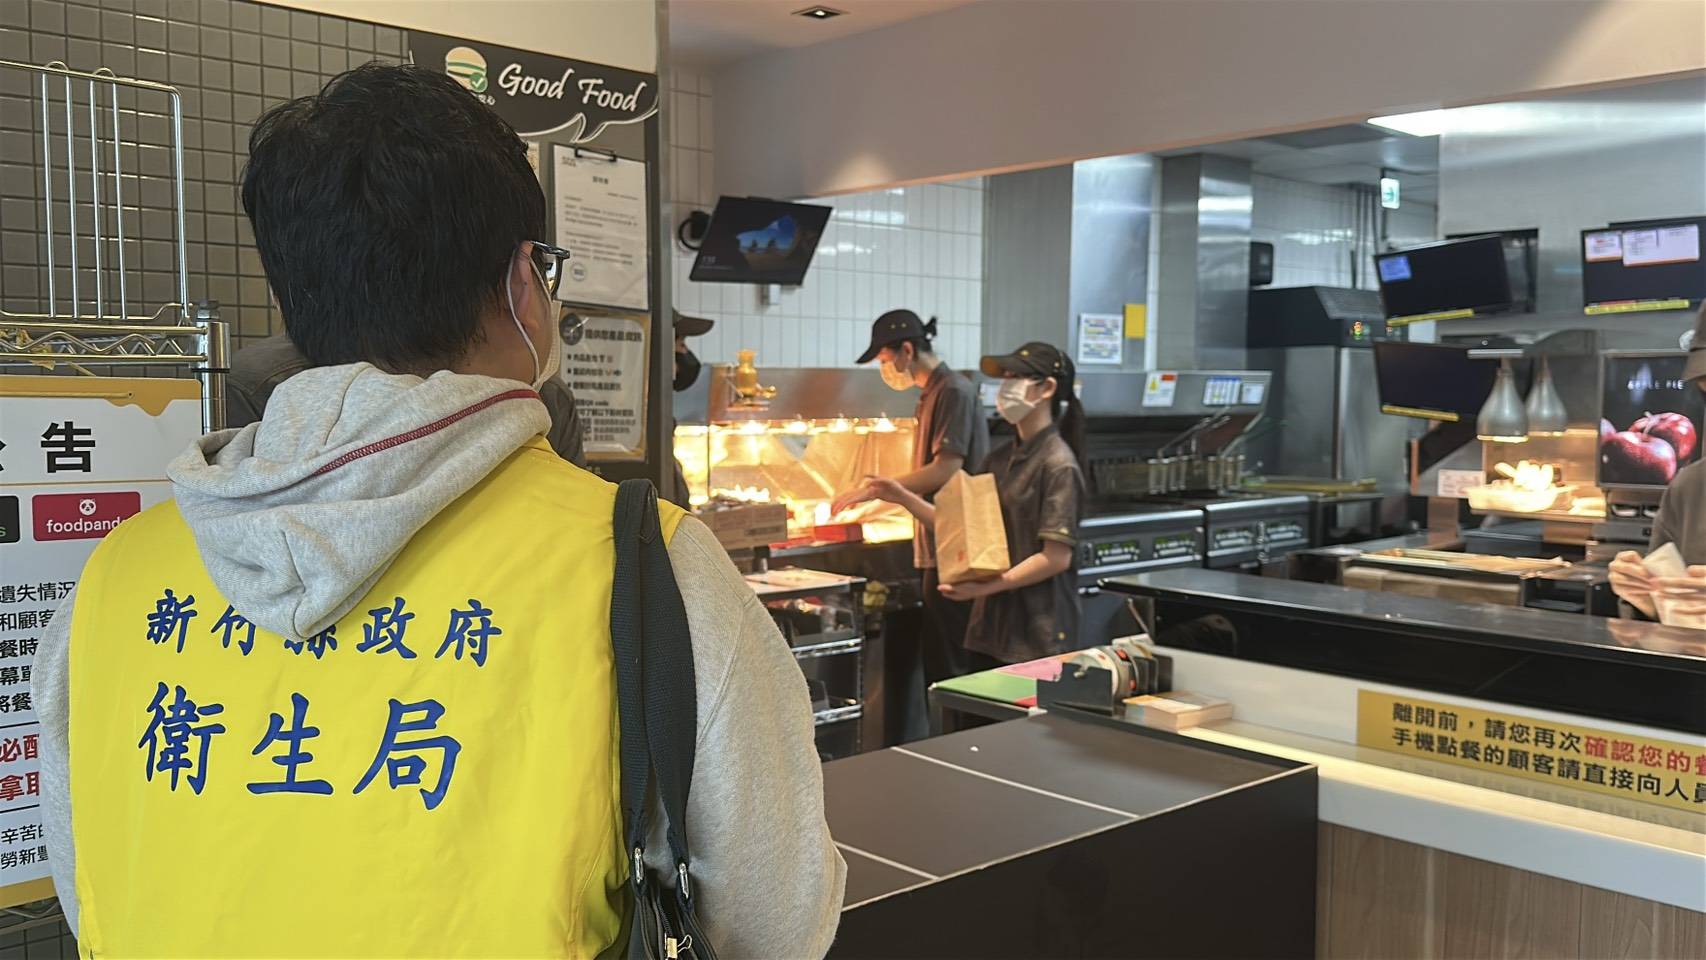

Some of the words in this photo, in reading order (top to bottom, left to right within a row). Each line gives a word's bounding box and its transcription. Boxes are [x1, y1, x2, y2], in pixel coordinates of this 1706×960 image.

[498, 63, 575, 99] Good
[578, 79, 647, 111] Food
[0, 421, 95, 473] 告
[46, 517, 120, 533] foodpand
[138, 682, 462, 810] 衛生局
